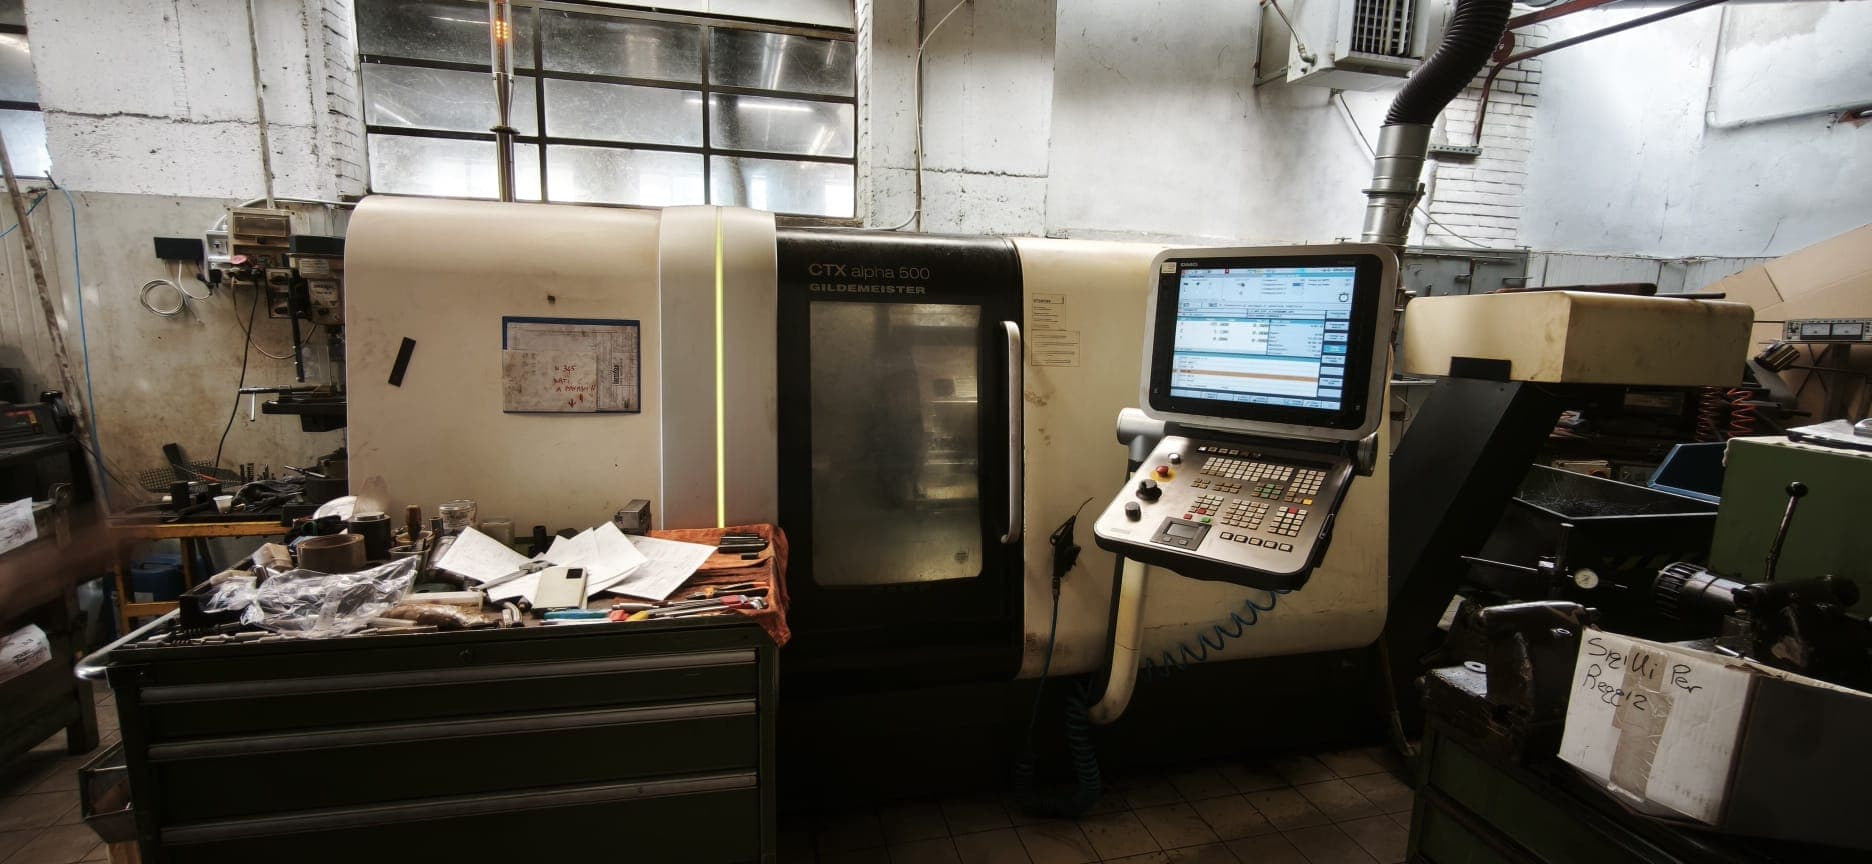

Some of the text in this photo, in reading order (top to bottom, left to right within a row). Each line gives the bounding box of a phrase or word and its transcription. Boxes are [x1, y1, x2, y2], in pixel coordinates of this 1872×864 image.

[808, 263, 930, 280] CTX alpha 500
[809, 283, 926, 295] GILDEMEISTER
